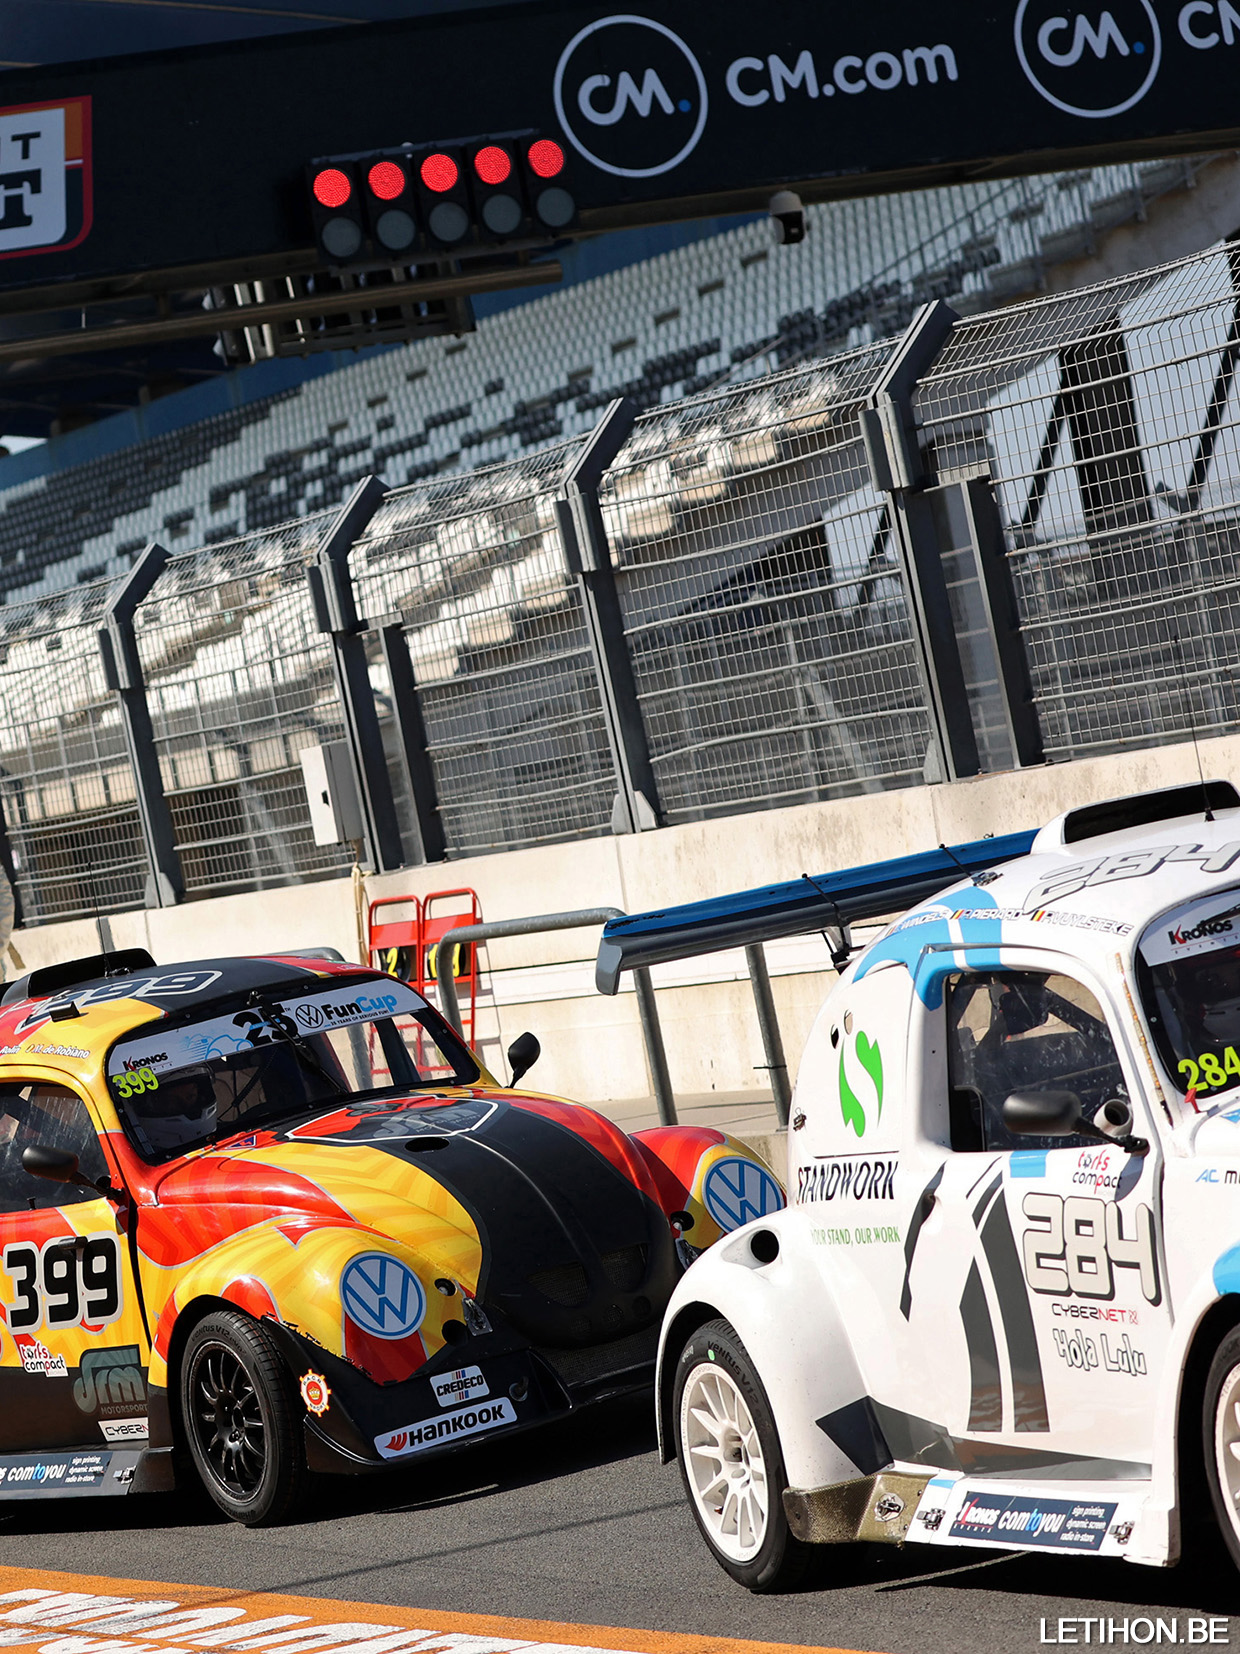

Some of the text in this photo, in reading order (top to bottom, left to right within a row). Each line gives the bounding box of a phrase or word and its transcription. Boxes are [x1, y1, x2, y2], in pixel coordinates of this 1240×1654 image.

[725, 44, 959, 107] CM.com
[320, 994, 398, 1021] FunCup
[123, 1052, 168, 1071] KRONOS
[112, 1068, 159, 1098] 399
[796, 1161, 898, 1206] STANDWORK
[1072, 1171, 1122, 1194] compact
[855, 1227, 872, 1244] OUR
[873, 1226, 900, 1243] WORK
[1022, 1191, 1162, 1307] 284
[4, 1233, 122, 1332] 399
[24, 1356, 65, 1375] compact
[436, 1374, 484, 1397] CREDECO
[7, 1463, 67, 1483] comtoyou
[998, 1508, 1066, 1537] comtoyou
